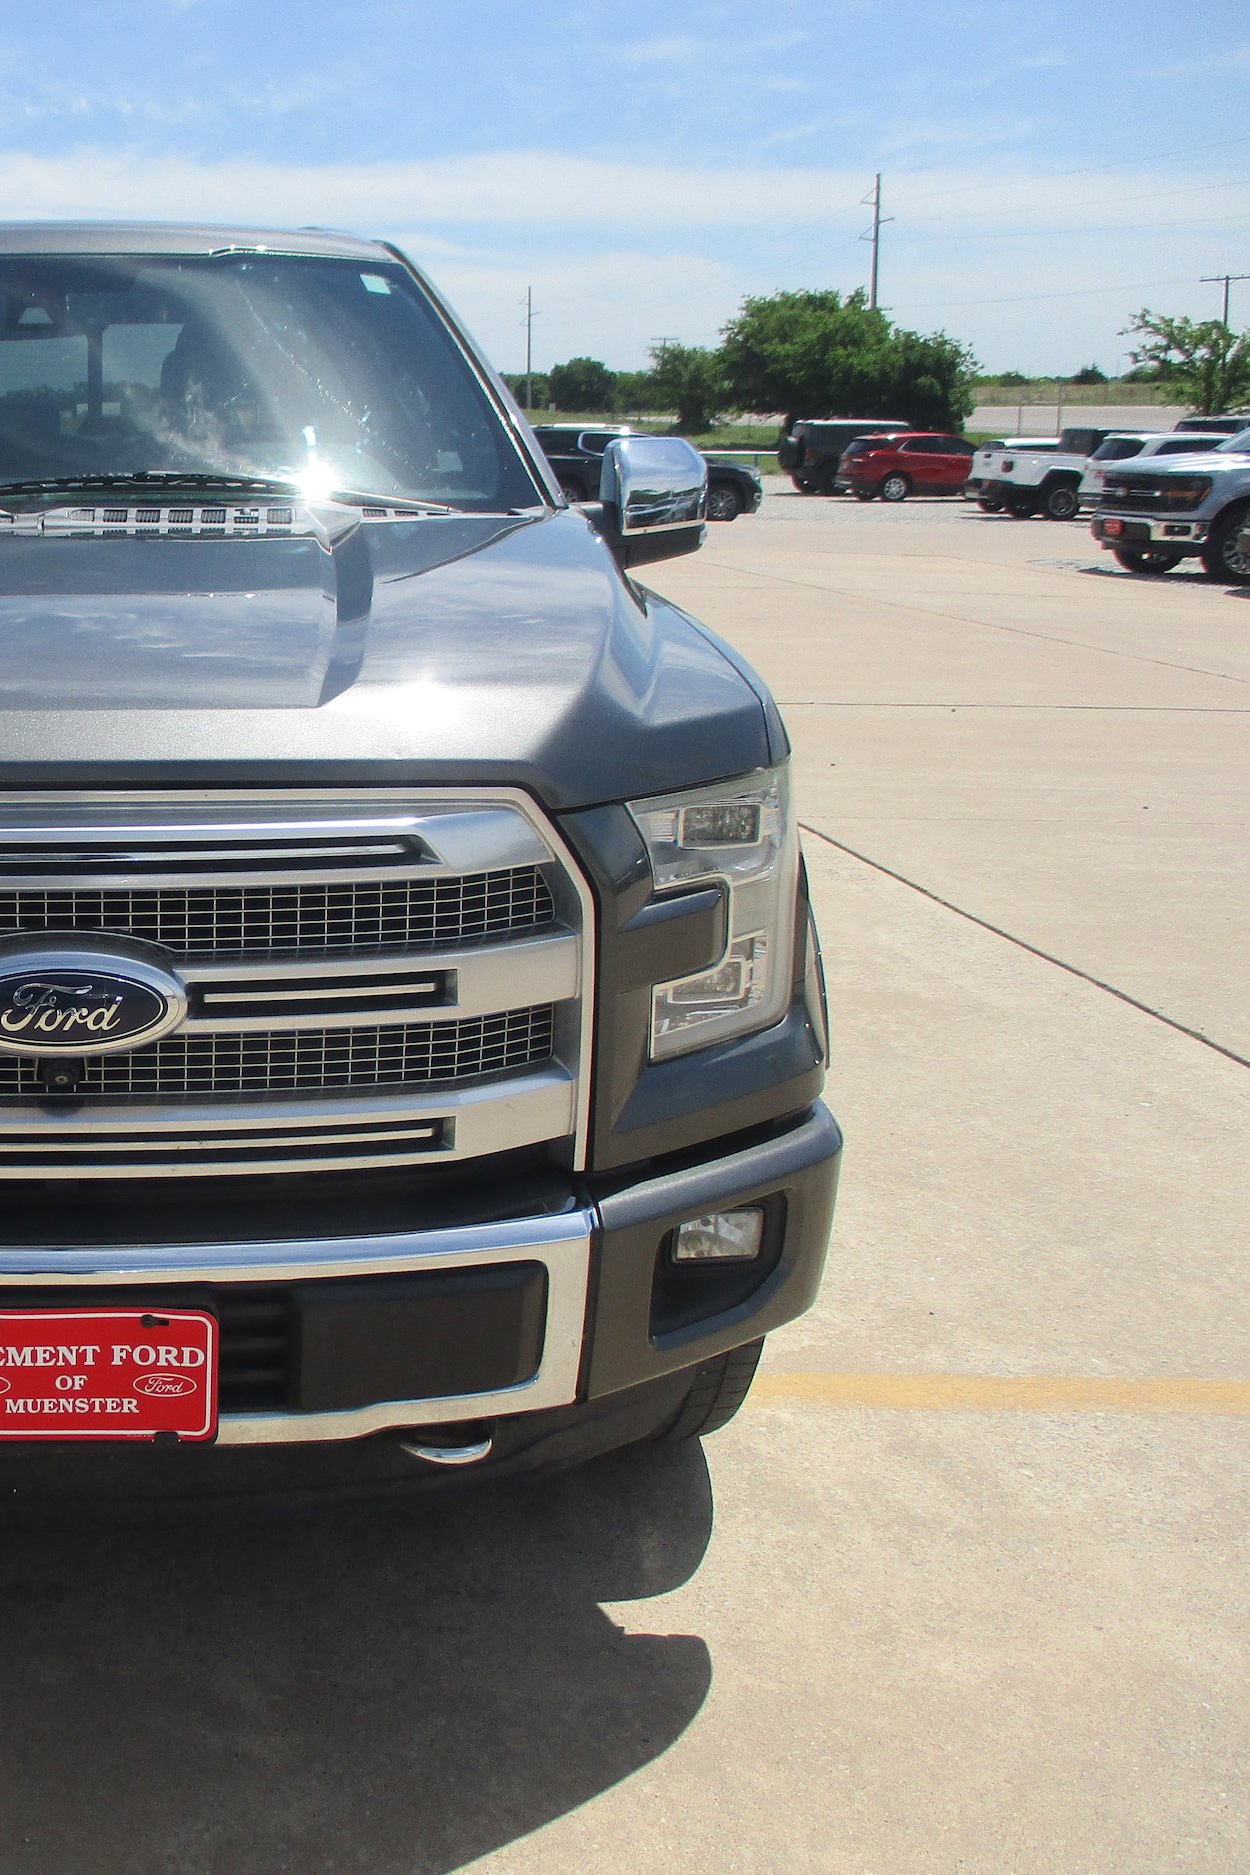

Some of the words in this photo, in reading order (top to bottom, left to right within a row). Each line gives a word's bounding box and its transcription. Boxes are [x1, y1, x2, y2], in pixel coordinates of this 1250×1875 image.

[1, 983, 123, 1032] Ford
[111, 1345, 205, 1367] FORD
[54, 1375, 88, 1391] OF
[143, 1376, 183, 1393] Ford
[4, 1398, 140, 1414] MUENSTER
